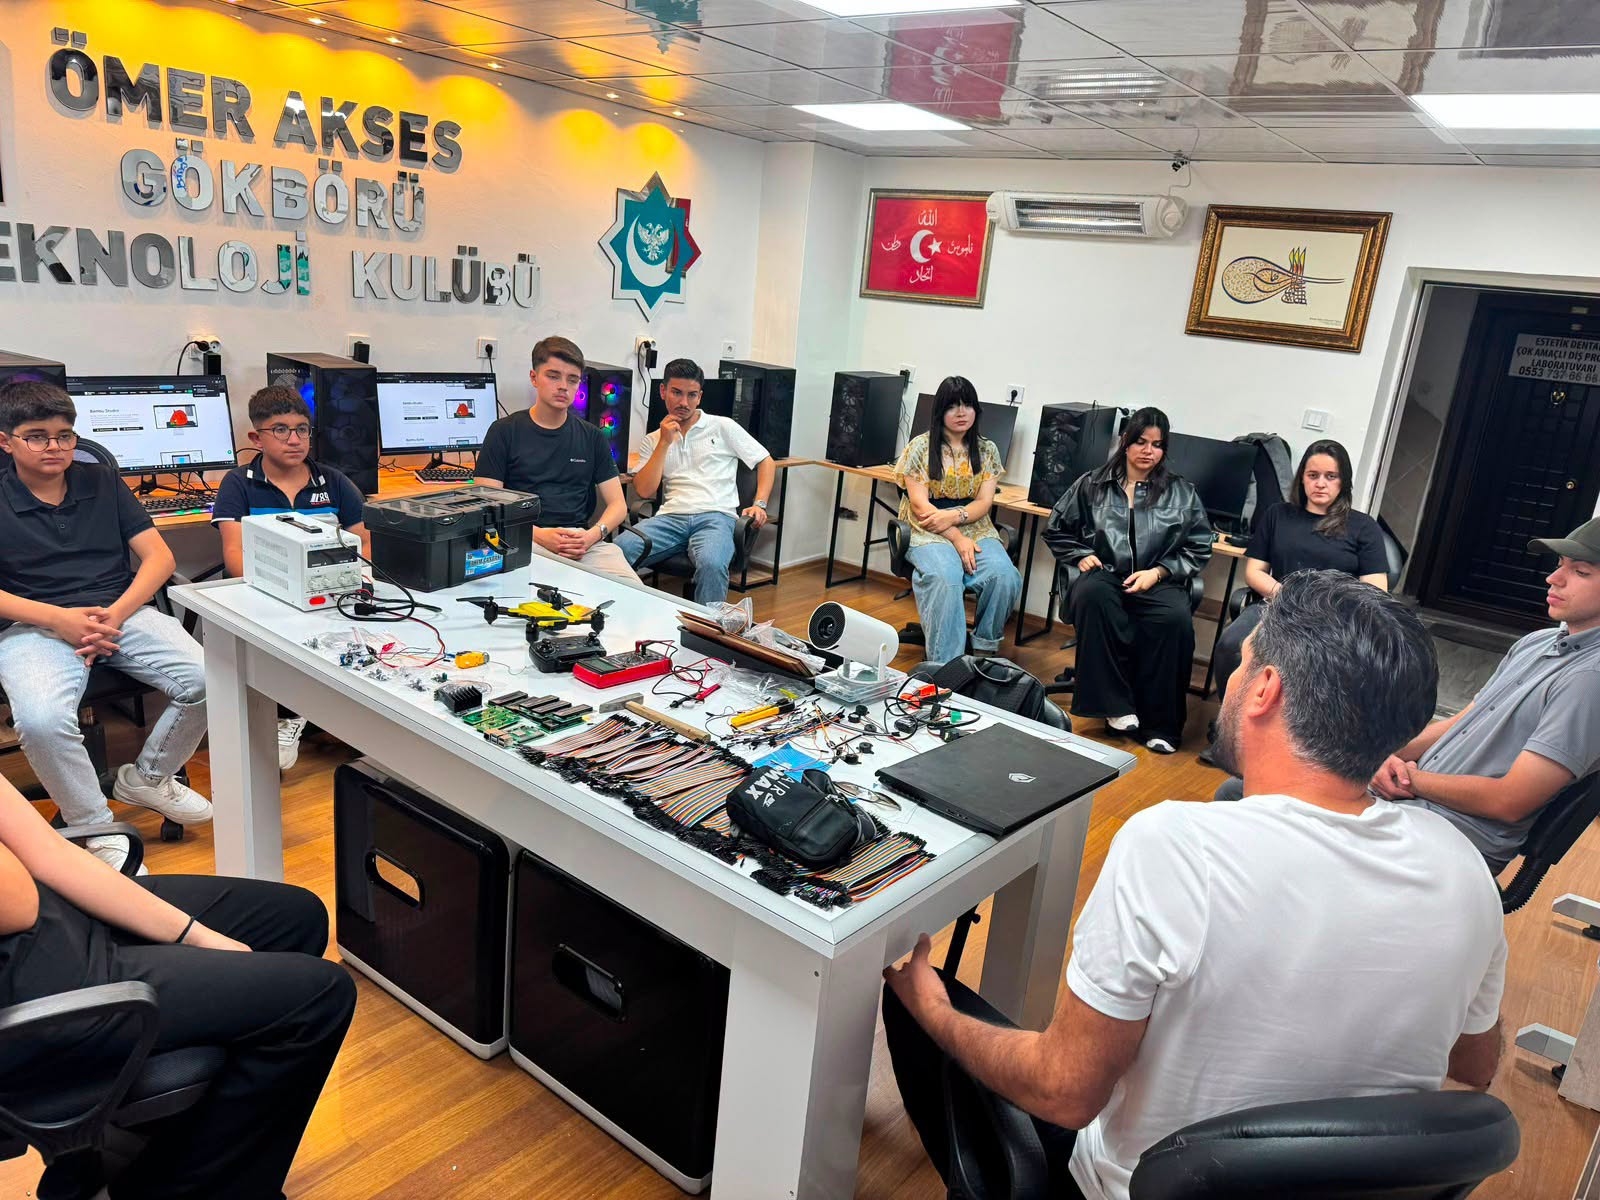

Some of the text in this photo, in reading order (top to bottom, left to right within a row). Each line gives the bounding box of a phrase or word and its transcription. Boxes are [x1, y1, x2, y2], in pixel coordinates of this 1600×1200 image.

[49, 27, 463, 173] ÖMER AKSES
[120, 137, 426, 233] GÖKBÖRÜ
[351, 244, 541, 309] KULÜBÜ
[1535, 337, 1569, 349] ESTETİK
[1516, 346, 1534, 357] ÇOK
[1534, 349, 1567, 360] AMAÇLI
[1568, 352, 1583, 363] DİŞ
[1518, 366, 1544, 377] 0553
[1531, 359, 1597, 373] LABORATUVARI
[745, 767, 786, 800] MAX
[770, 777, 795, 796] AIR
